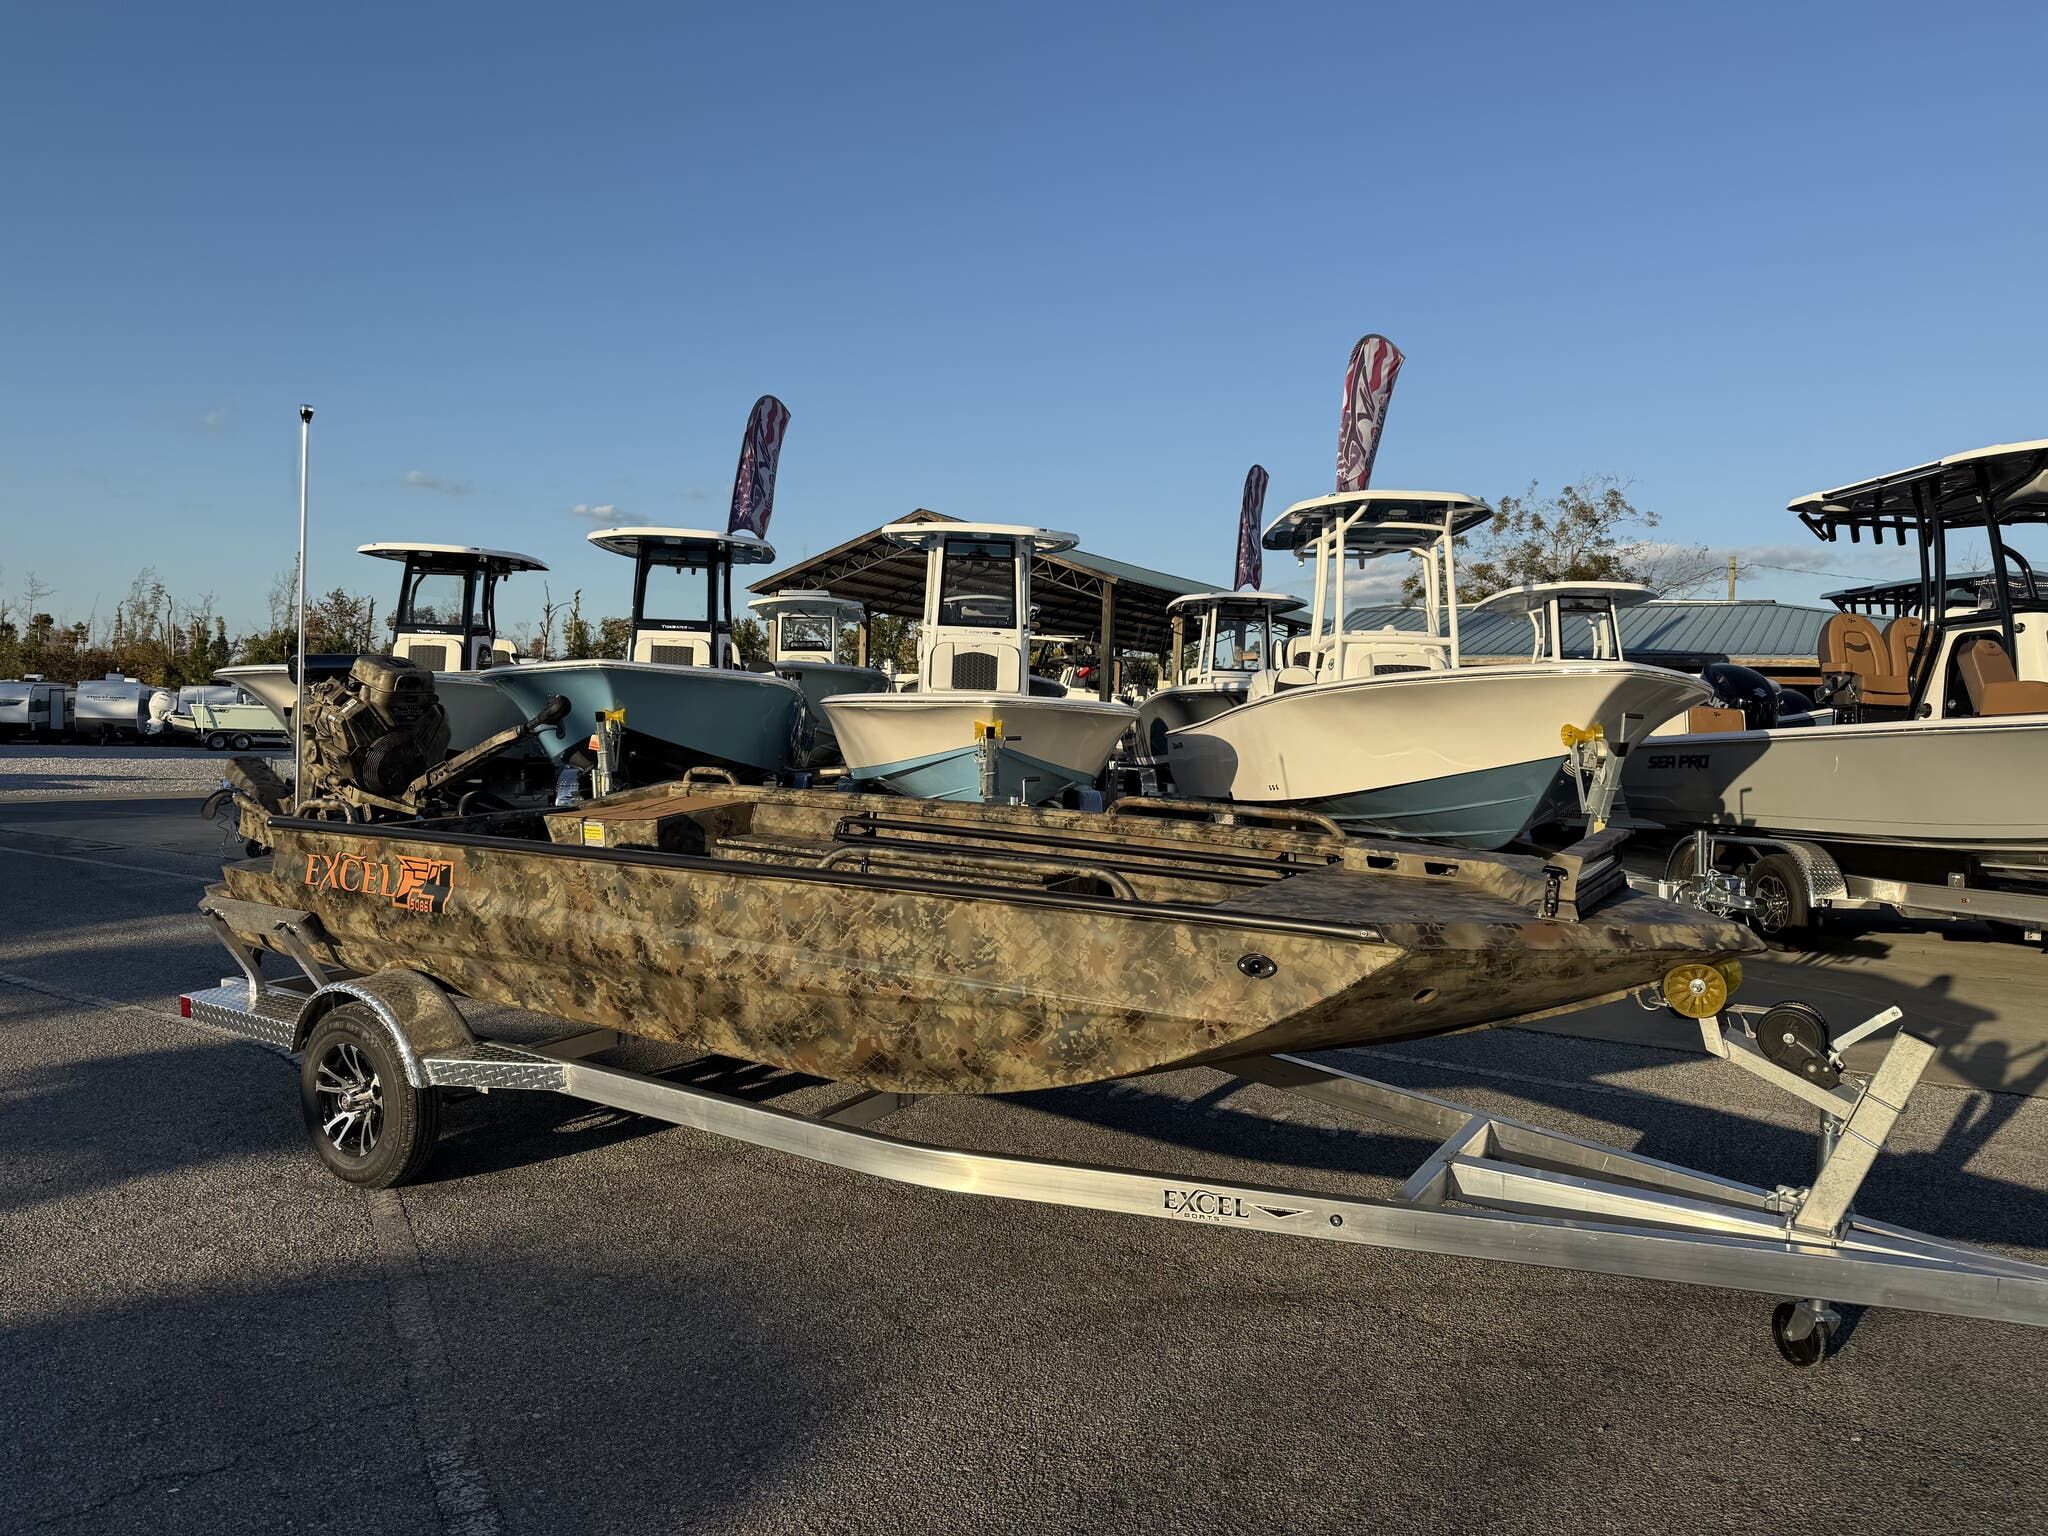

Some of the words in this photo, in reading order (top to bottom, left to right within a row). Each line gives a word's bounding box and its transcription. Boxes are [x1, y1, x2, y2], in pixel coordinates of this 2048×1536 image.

[1648, 756, 1676, 769] SEA
[1679, 755, 1710, 772] PRO
[304, 851, 397, 898] EXCEL
[1163, 1189, 1250, 1218] EXCEL
[1184, 1212, 1220, 1221] BOATS
